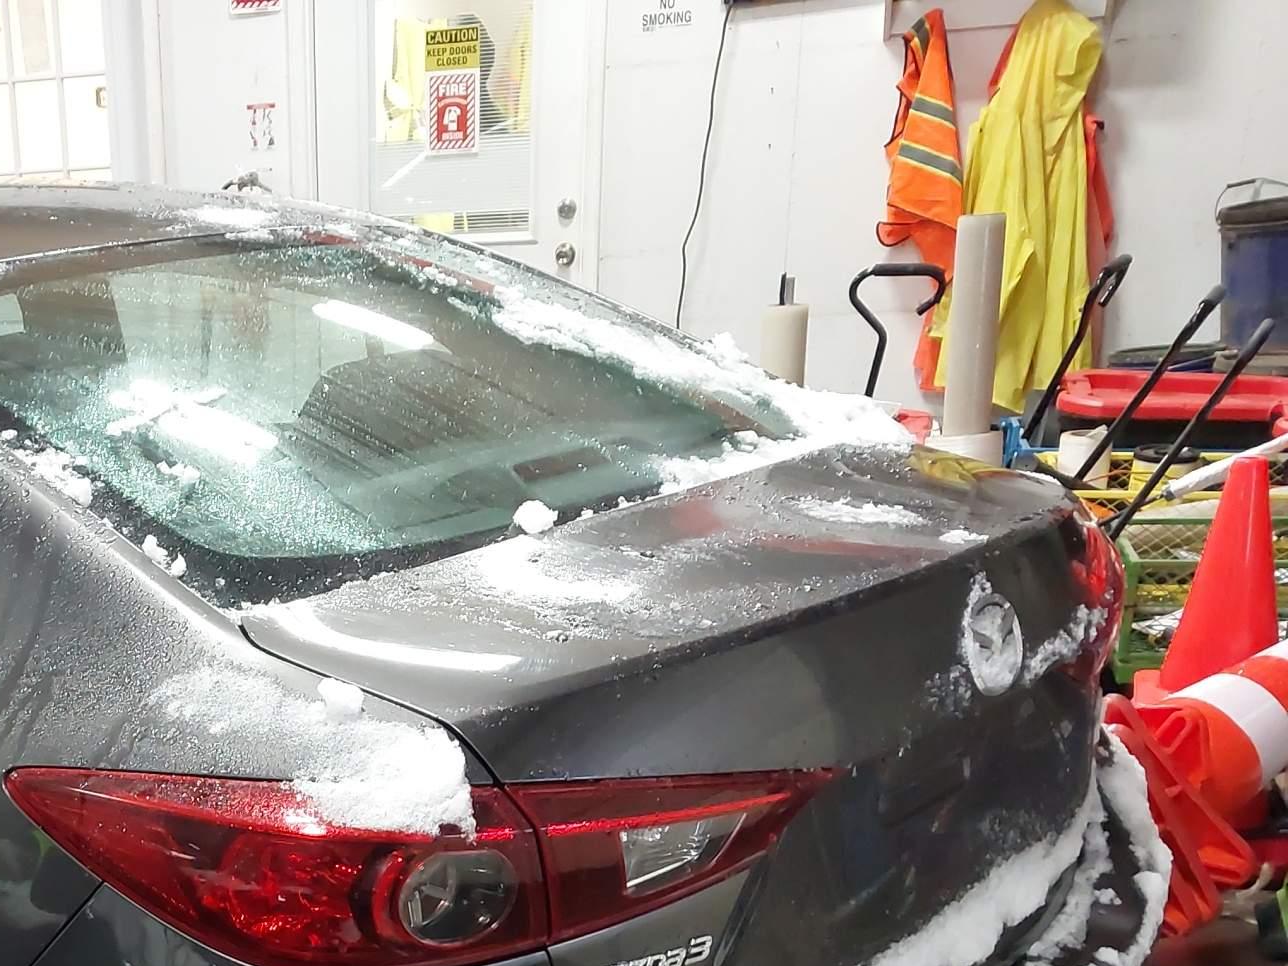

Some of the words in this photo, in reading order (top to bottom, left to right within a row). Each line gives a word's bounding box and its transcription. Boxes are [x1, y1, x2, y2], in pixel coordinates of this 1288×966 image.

[659, 0, 676, 9] NO
[642, 10, 692, 26] SMOKING
[427, 28, 477, 44] CAUTION
[427, 47, 447, 57] KEEP
[449, 45, 478, 56] DOORS
[436, 56, 468, 66] CLOSED
[438, 82, 467, 97] FIRE
